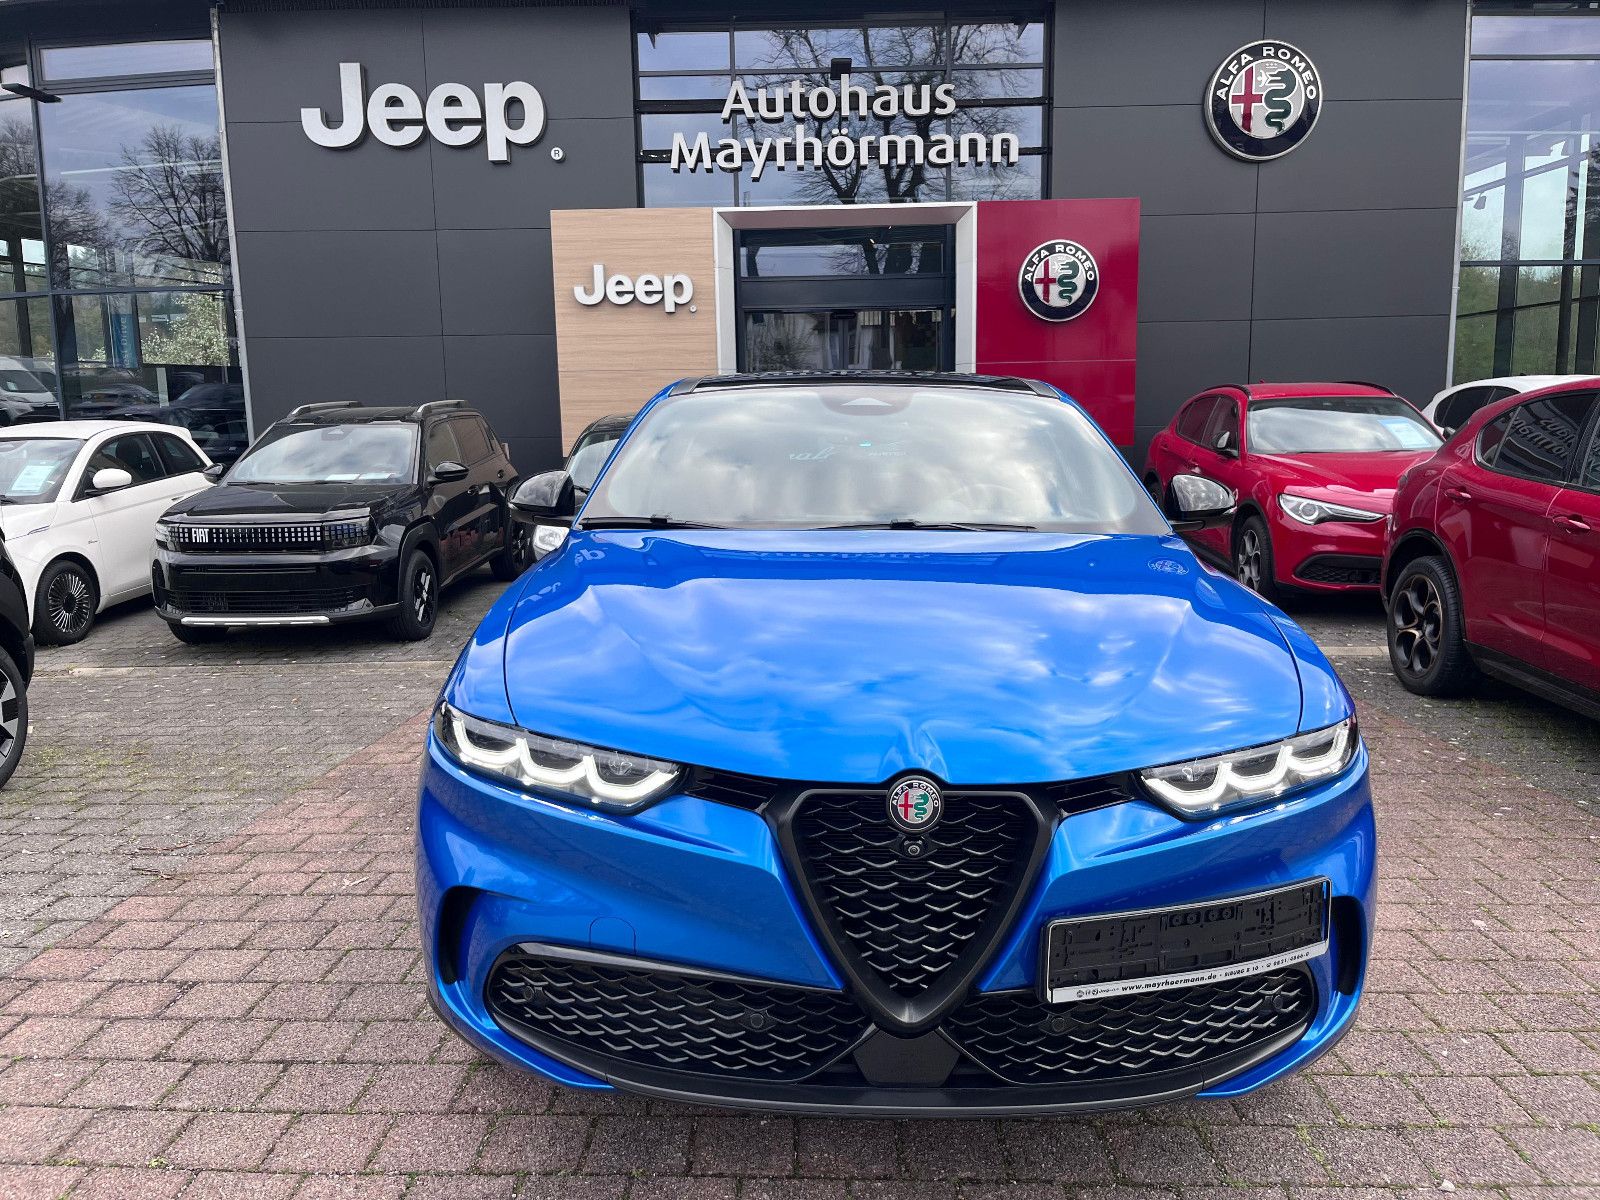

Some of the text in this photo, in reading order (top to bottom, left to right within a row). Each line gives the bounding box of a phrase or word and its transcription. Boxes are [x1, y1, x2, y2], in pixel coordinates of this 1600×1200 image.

[721, 73, 956, 121] Autohaus
[1216, 46, 1317, 101] ALFA ROMEO
[300, 62, 545, 161] Jeep
[670, 124, 1020, 179] Mayrhörmann
[1024, 244, 1095, 282] ALFA ROMEO
[573, 264, 693, 313] Jeep
[192, 528, 209, 543] FIAT
[892, 782, 939, 807] ALFA ROMEO
[1121, 972, 1217, 992] www.mayrhoermann.de
